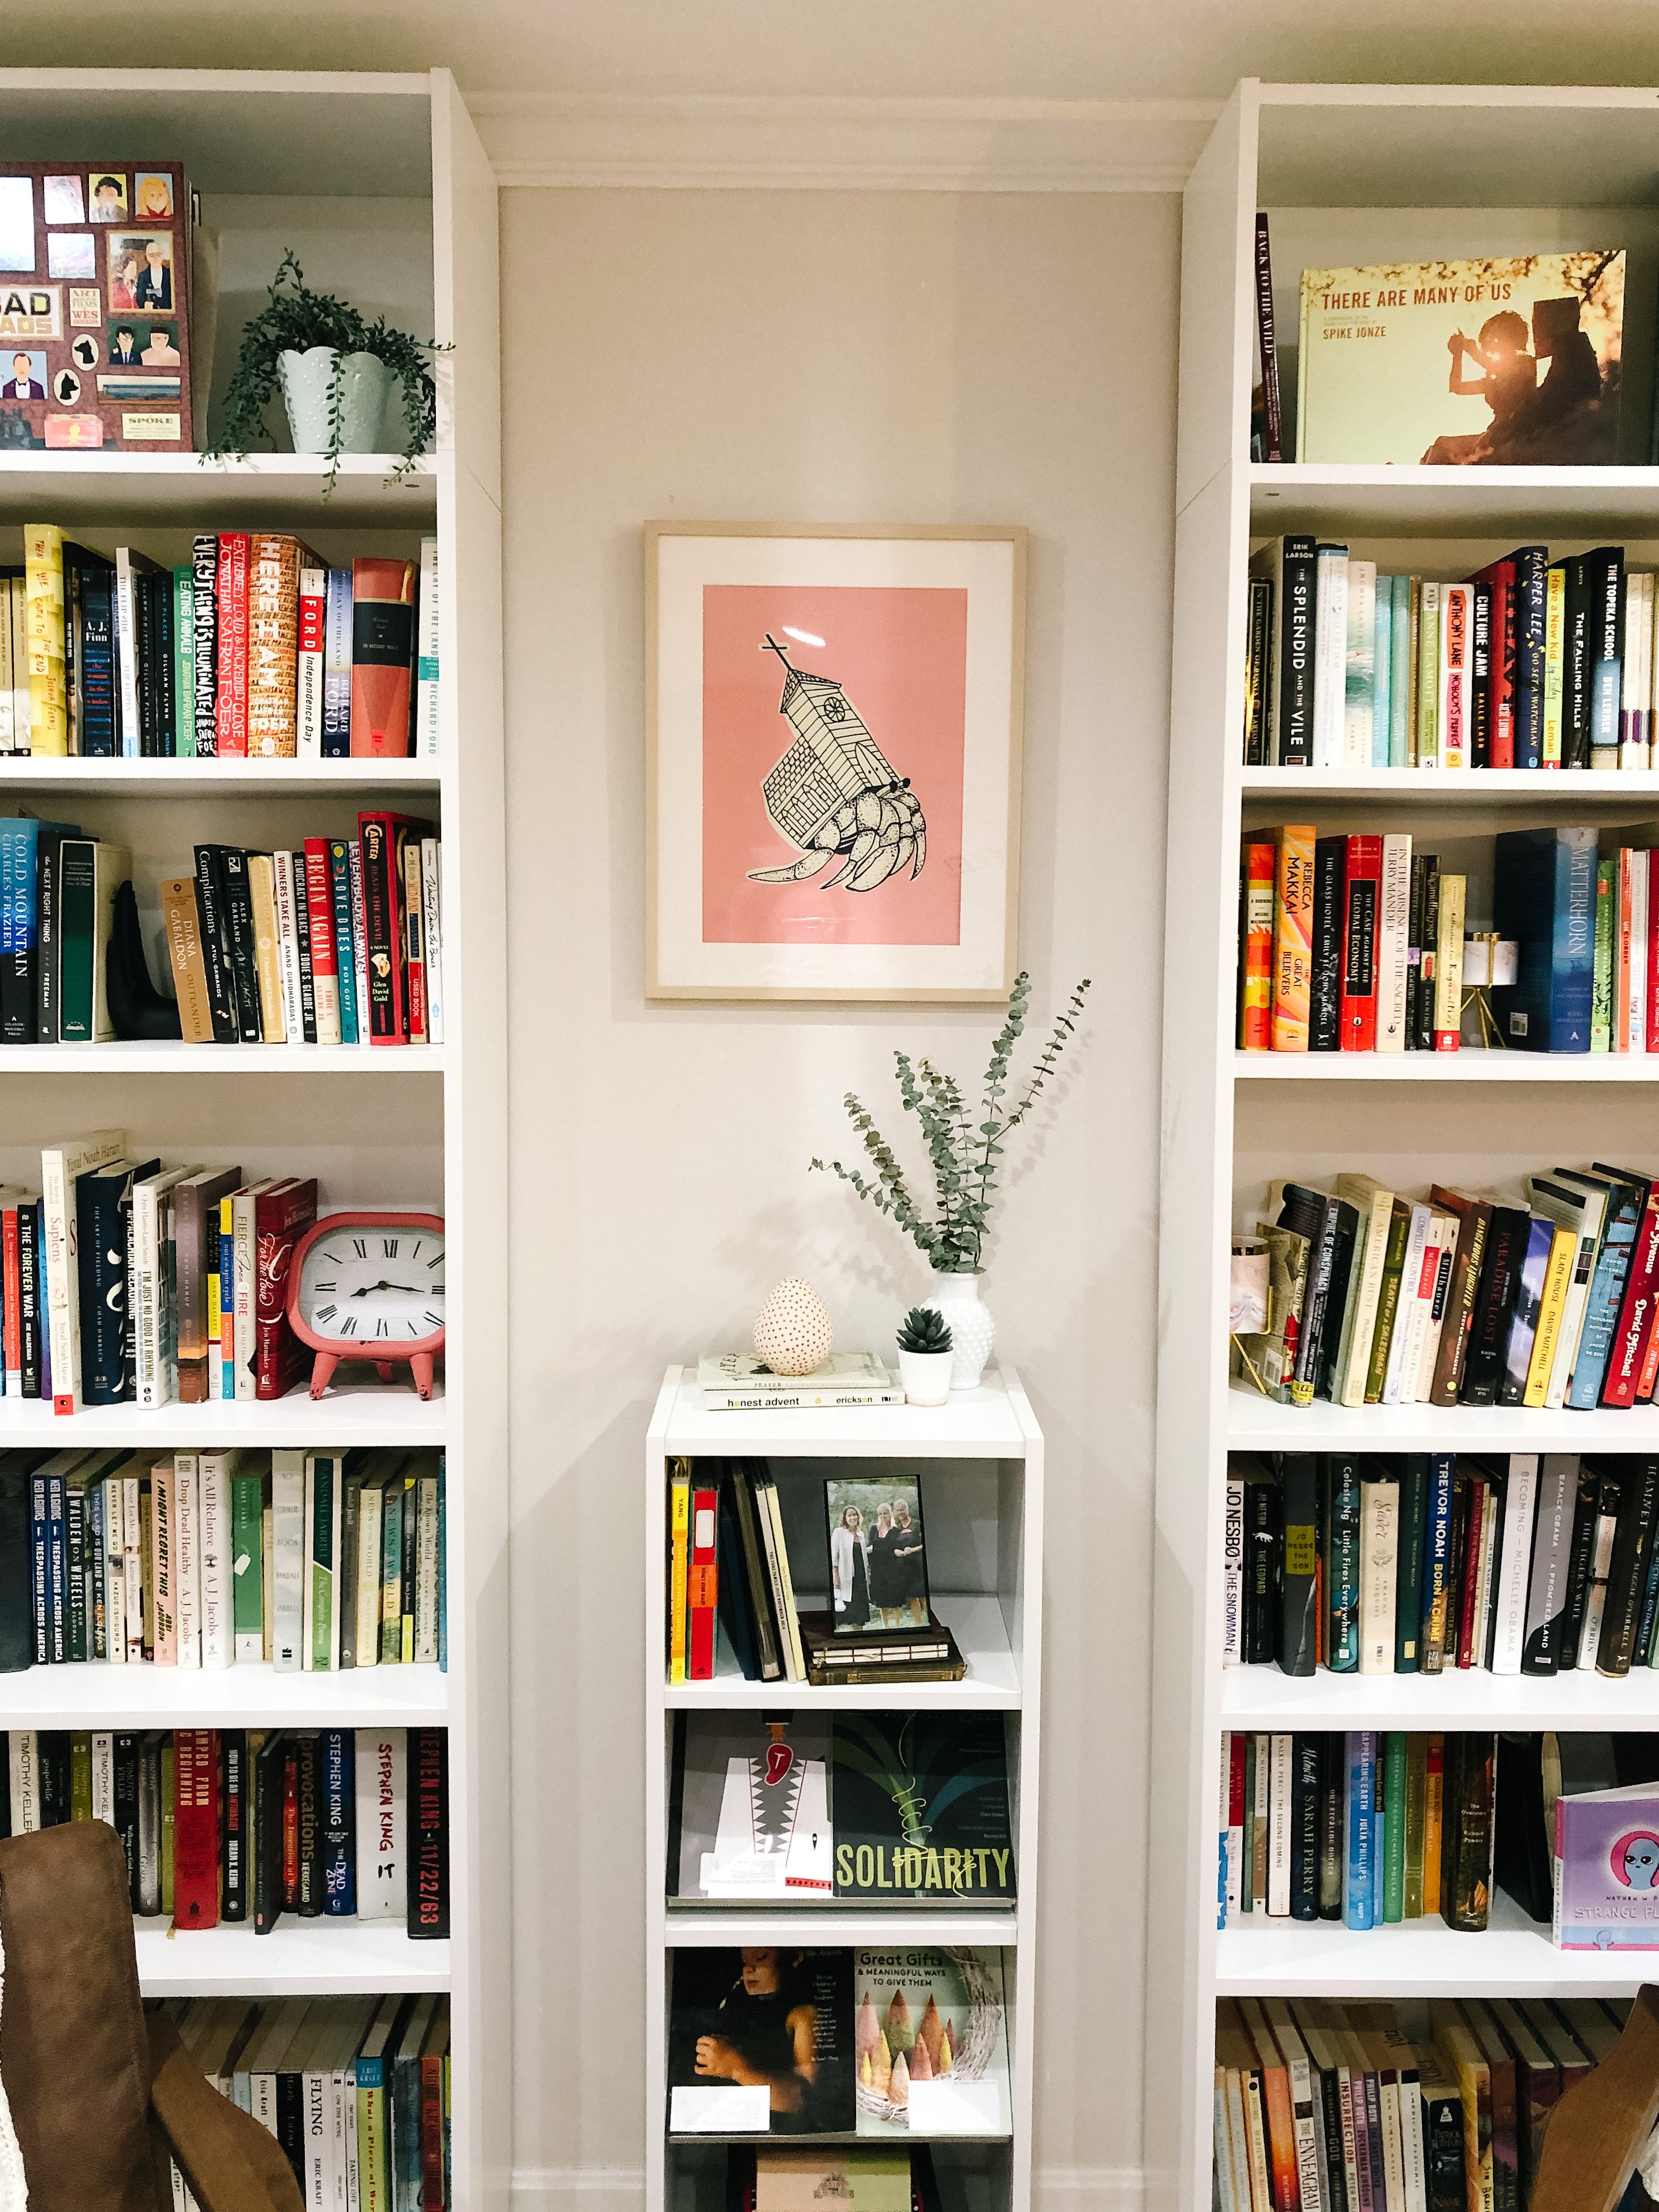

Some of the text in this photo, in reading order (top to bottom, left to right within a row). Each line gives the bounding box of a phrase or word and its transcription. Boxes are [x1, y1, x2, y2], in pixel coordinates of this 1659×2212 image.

[0, 293, 50, 315] AD
[73, 310, 99, 319] WES
[1322, 283, 1512, 311] THERE ARE MANY OF US
[1322, 326, 1386, 339] SPIKE JONZE
[233, 540, 245, 599] EXTREMELY
[259, 543, 279, 612] HERE
[1551, 575, 1559, 602] Have
[233, 600, 245, 634] LOUD
[1531, 552, 1543, 635] HARPER LEE
[1604, 565, 1617, 661] THE TOPEKA SCHOOL
[85, 633, 107, 642] Finn
[220, 540, 231, 735] JONATHAN SAFRAN FOER
[1292, 586, 1306, 670] SPLENDID
[1451, 595, 1463, 666] ANTHONY LANE
[1475, 596, 1488, 677] CULTURE JAM
[1550, 615, 1559, 637] New
[1550, 640, 1558, 659] Kid
[259, 647, 279, 686] AM
[302, 599, 317, 742] FORD Independence Day
[1574, 612, 1585, 728] THE FALLING HILLS
[232, 697, 245, 738] CLOSE
[1291, 711, 1304, 746] VILE
[1601, 676, 1613, 734] BEN LERNER
[1450, 718, 1459, 747] PERFECT
[1548, 720, 1556, 754] Leman
[2, 833, 12, 947] CHARLES FRAZIER
[199, 851, 215, 934] Complications
[278, 857, 288, 896] WINNERS
[1285, 857, 1301, 914] MAKKAI
[1301, 862, 1313, 910] REBECCA
[14, 833, 27, 977] COLD MOUNTAIN
[281, 899, 289, 921] TAKE
[307, 854, 330, 960] BEGIN AGAIN
[335, 877, 350, 952] LOVE DOES
[1568, 847, 1589, 955] MATTERHORN
[171, 910, 188, 970] GABALDON
[183, 920, 196, 957] DIANA
[286, 971, 296, 1022] GIRIDHARADAS
[1281, 951, 1292, 996] BELIEVERS
[1293, 958, 1302, 988] GREAT
[48, 1217, 61, 1264] Sapiens
[21, 1225, 34, 1317] THE FOREVER WAR
[1538, 1252, 1567, 1371] SLADE HOUSE DAVID MITCHELL
[1620, 1299, 1647, 1377] David Mitchell
[766, 1397, 799, 1407] advent
[158, 1486, 167, 1525] MIGHT
[206, 1485, 215, 1501] All
[1228, 1487, 1240, 1507] JO
[1436, 1462, 1449, 1515] TREVOR
[1556, 1474, 1565, 1514] BARACK
[69, 1500, 81, 1545] WALDEN
[179, 1479, 190, 1577] Drop Dead Healthy
[206, 1504, 215, 1547] Relative
[1435, 1520, 1446, 1557] NOAH
[1552, 1514, 1561, 1547] OBAMA
[159, 1527, 168, 1571] REGRET
[1340, 1466, 1351, 1643] Celeste Ng Little Fires Everywhere
[1508, 1472, 1529, 1653] BECOMING MICHELLE OBAMA
[70, 1564, 83, 1608] WHEELS
[159, 1572, 168, 1597] THIS
[1227, 1571, 1238, 1590] THE
[1433, 1564, 1443, 1596] BORN
[1545, 1572, 1555, 1622] PROMISED
[1226, 1593, 1236, 1646] SNOWMAN
[1431, 1605, 1441, 1642] CRIME
[21, 1735, 30, 1787] TIMOTHY
[330, 1734, 345, 1889] STEPHEN KING DEAD
[378, 1744, 395, 1878] STEPHEN KING IT
[1359, 1785, 1368, 1881] EARTH JULIA PHILLIPS
[836, 1844, 1010, 1889] SOLIDARITY
[1303, 1795, 1314, 1896] SARAH PERRY
[326, 1869, 336, 1895] ZONE
[419, 1845, 439, 1924] 11/22/63
[1574, 1906, 1636, 1918] STRANGE
[861, 1953, 943, 1966] Great Gifts
[311, 2079, 323, 2136] FLYING
[1341, 2081, 1354, 2163] INSURRECTION
[1299, 2138, 1319, 2211] ENNEAGRAM
